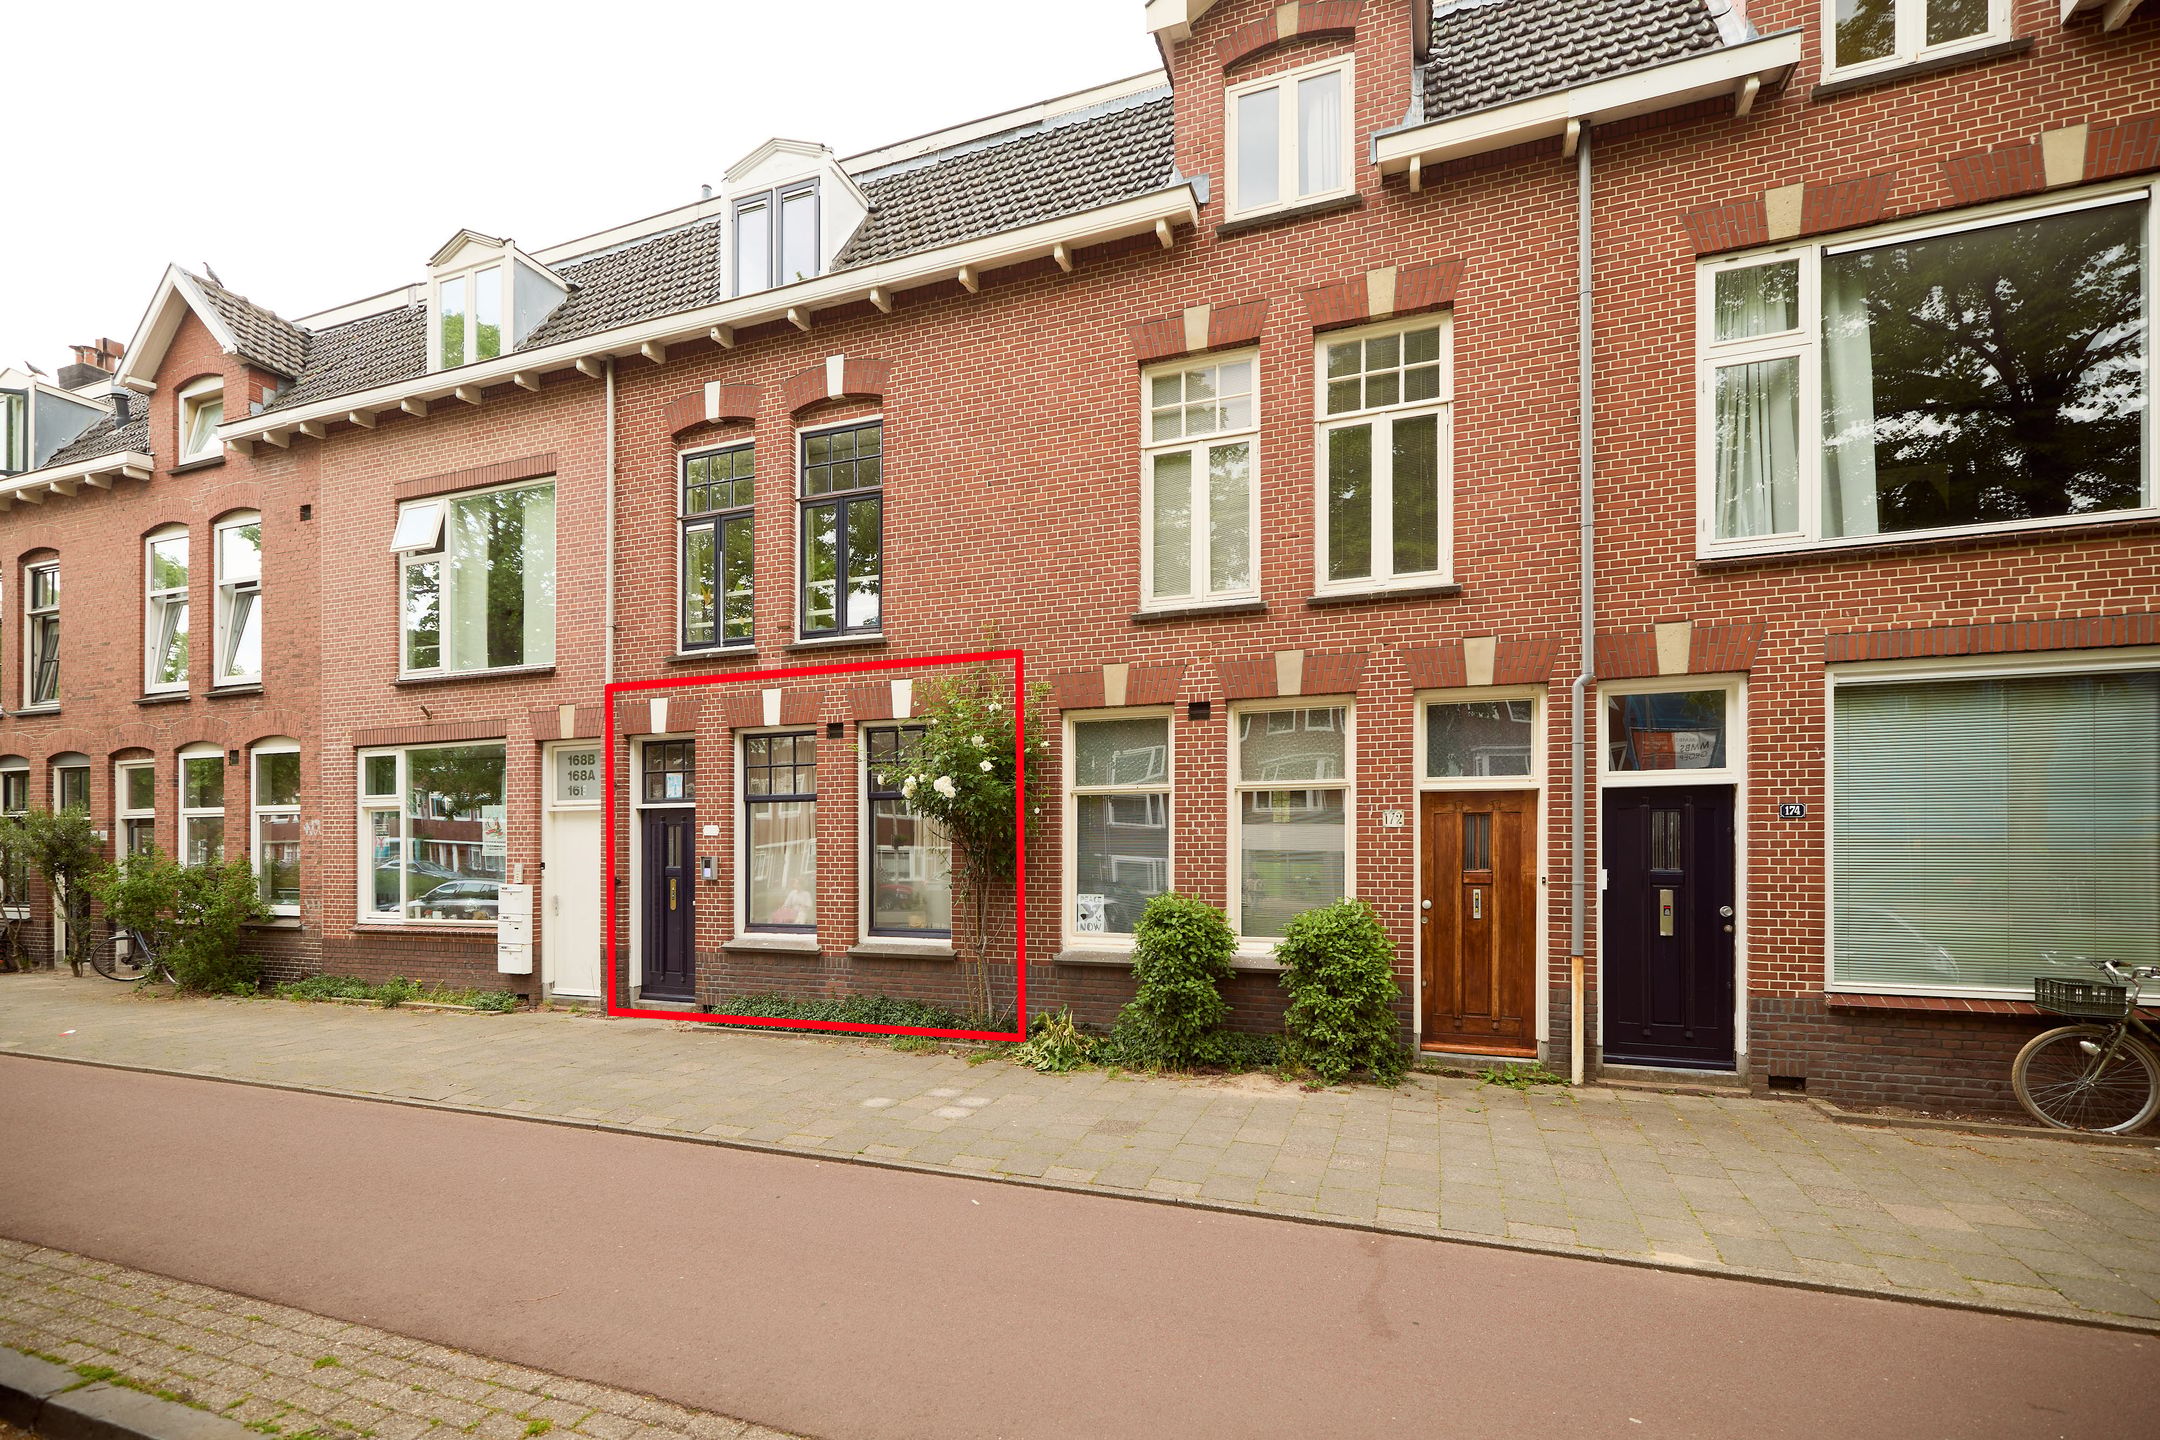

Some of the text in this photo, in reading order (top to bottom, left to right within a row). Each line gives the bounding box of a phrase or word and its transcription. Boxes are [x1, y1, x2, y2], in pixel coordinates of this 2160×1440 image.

[567, 754, 596, 766] 168B
[567, 769, 596, 781] 168A
[1784, 804, 1801, 816] 174
[1385, 811, 1403, 825] 172
[1080, 922, 1102, 932] NOW
